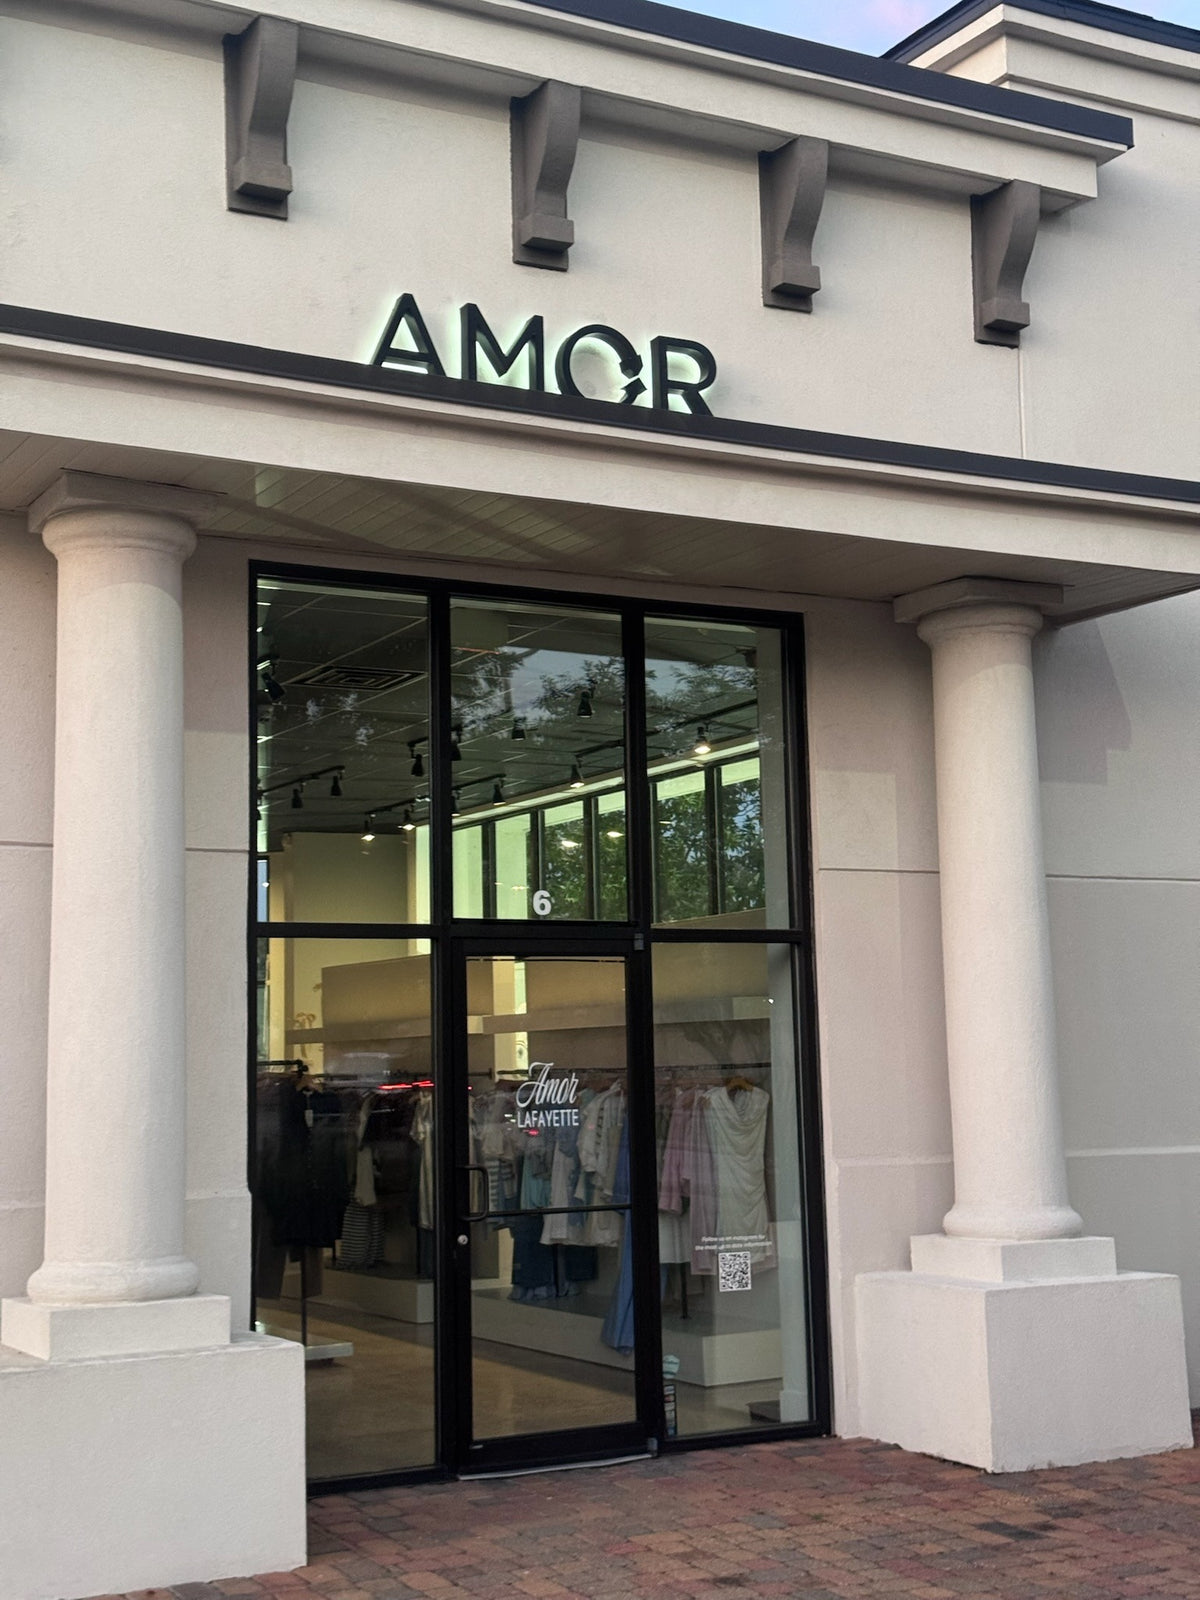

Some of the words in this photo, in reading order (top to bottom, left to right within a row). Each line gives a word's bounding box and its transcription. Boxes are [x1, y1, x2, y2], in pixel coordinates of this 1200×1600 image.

[369, 292, 717, 416] AMOR
[532, 889, 552, 916] 6
[516, 1061, 579, 1108] Amor
[517, 1108, 580, 1128] LAFAYETTE
